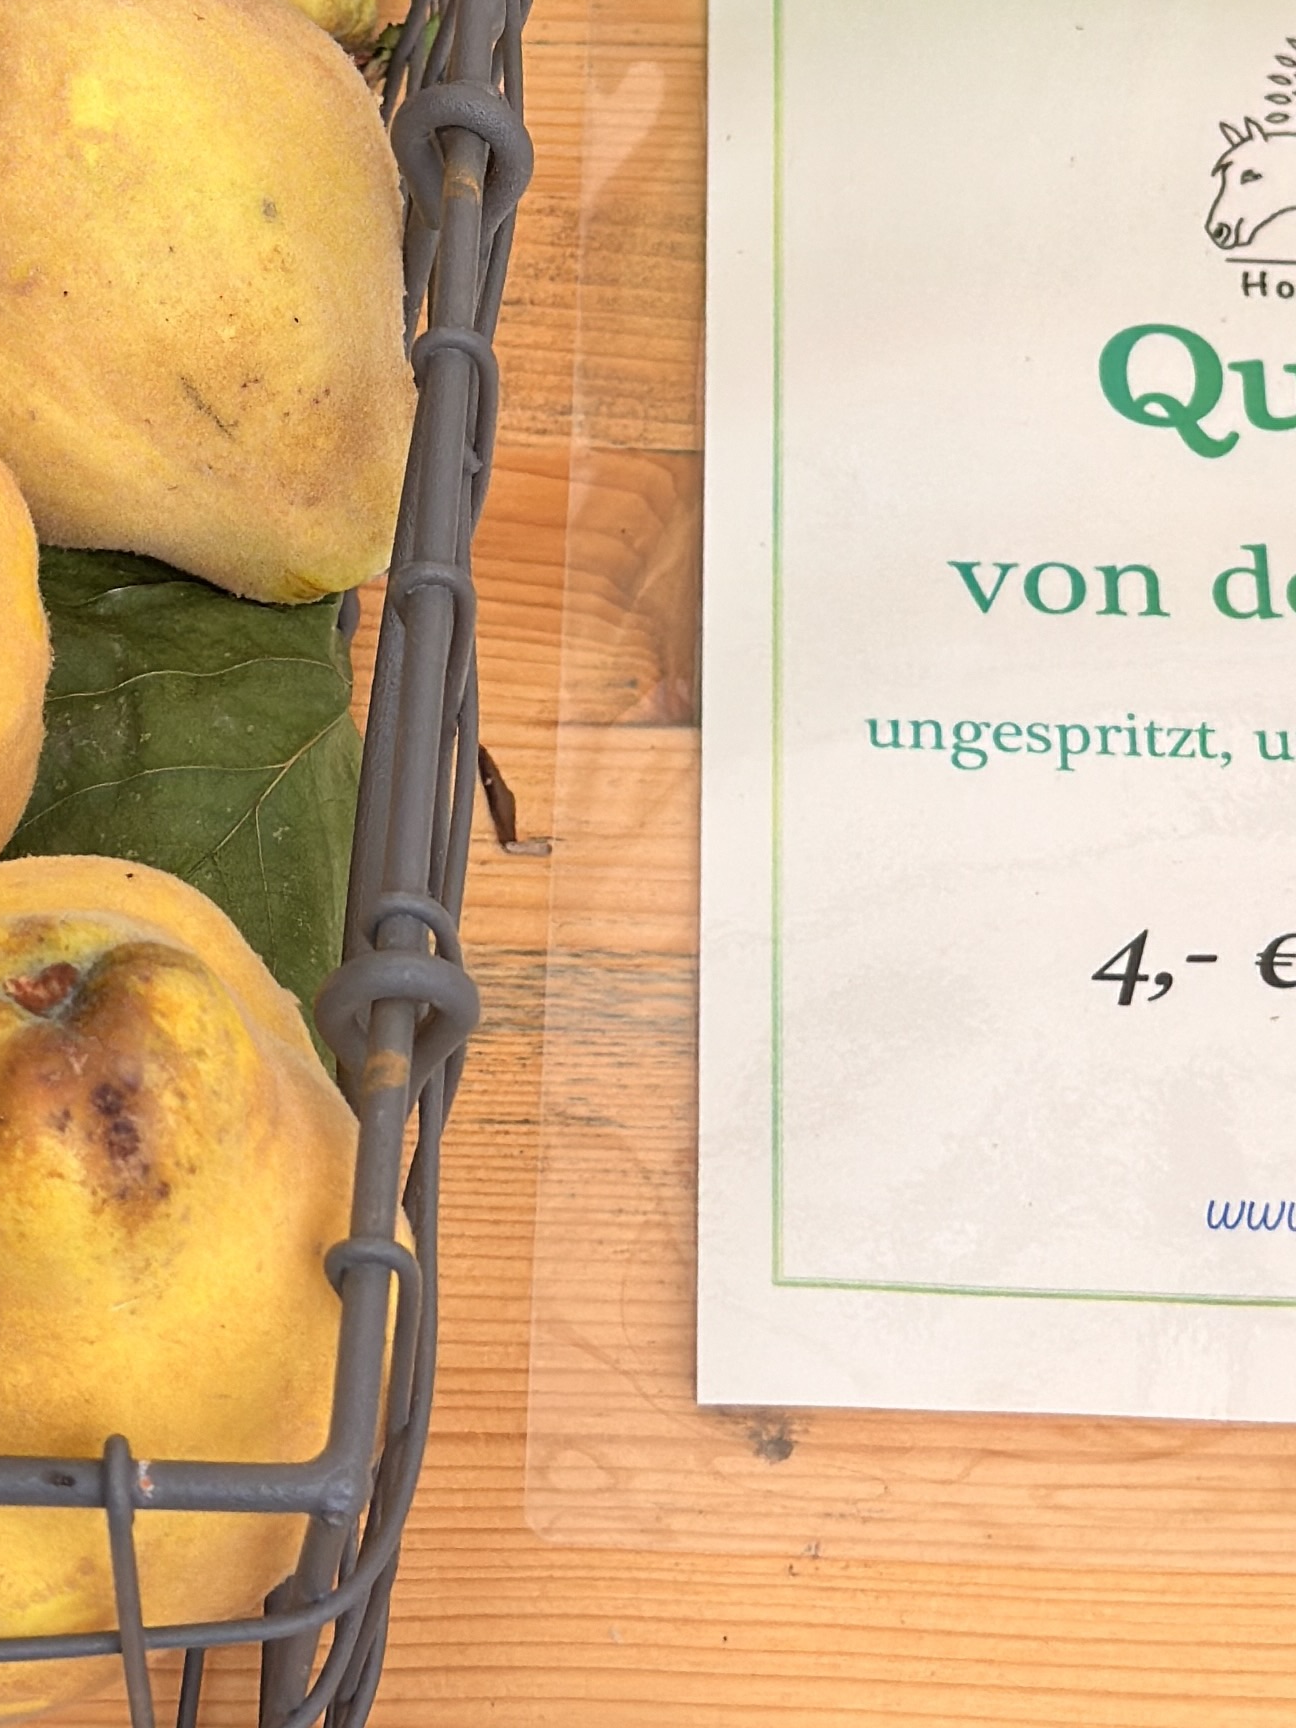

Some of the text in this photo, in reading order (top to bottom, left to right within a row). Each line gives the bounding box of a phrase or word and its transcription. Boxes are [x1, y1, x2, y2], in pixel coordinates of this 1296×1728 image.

[947, 558, 1171, 620] von
[865, 712, 1233, 772] ungespritzt,
[1090, 928, 1219, 1006] 4,-
